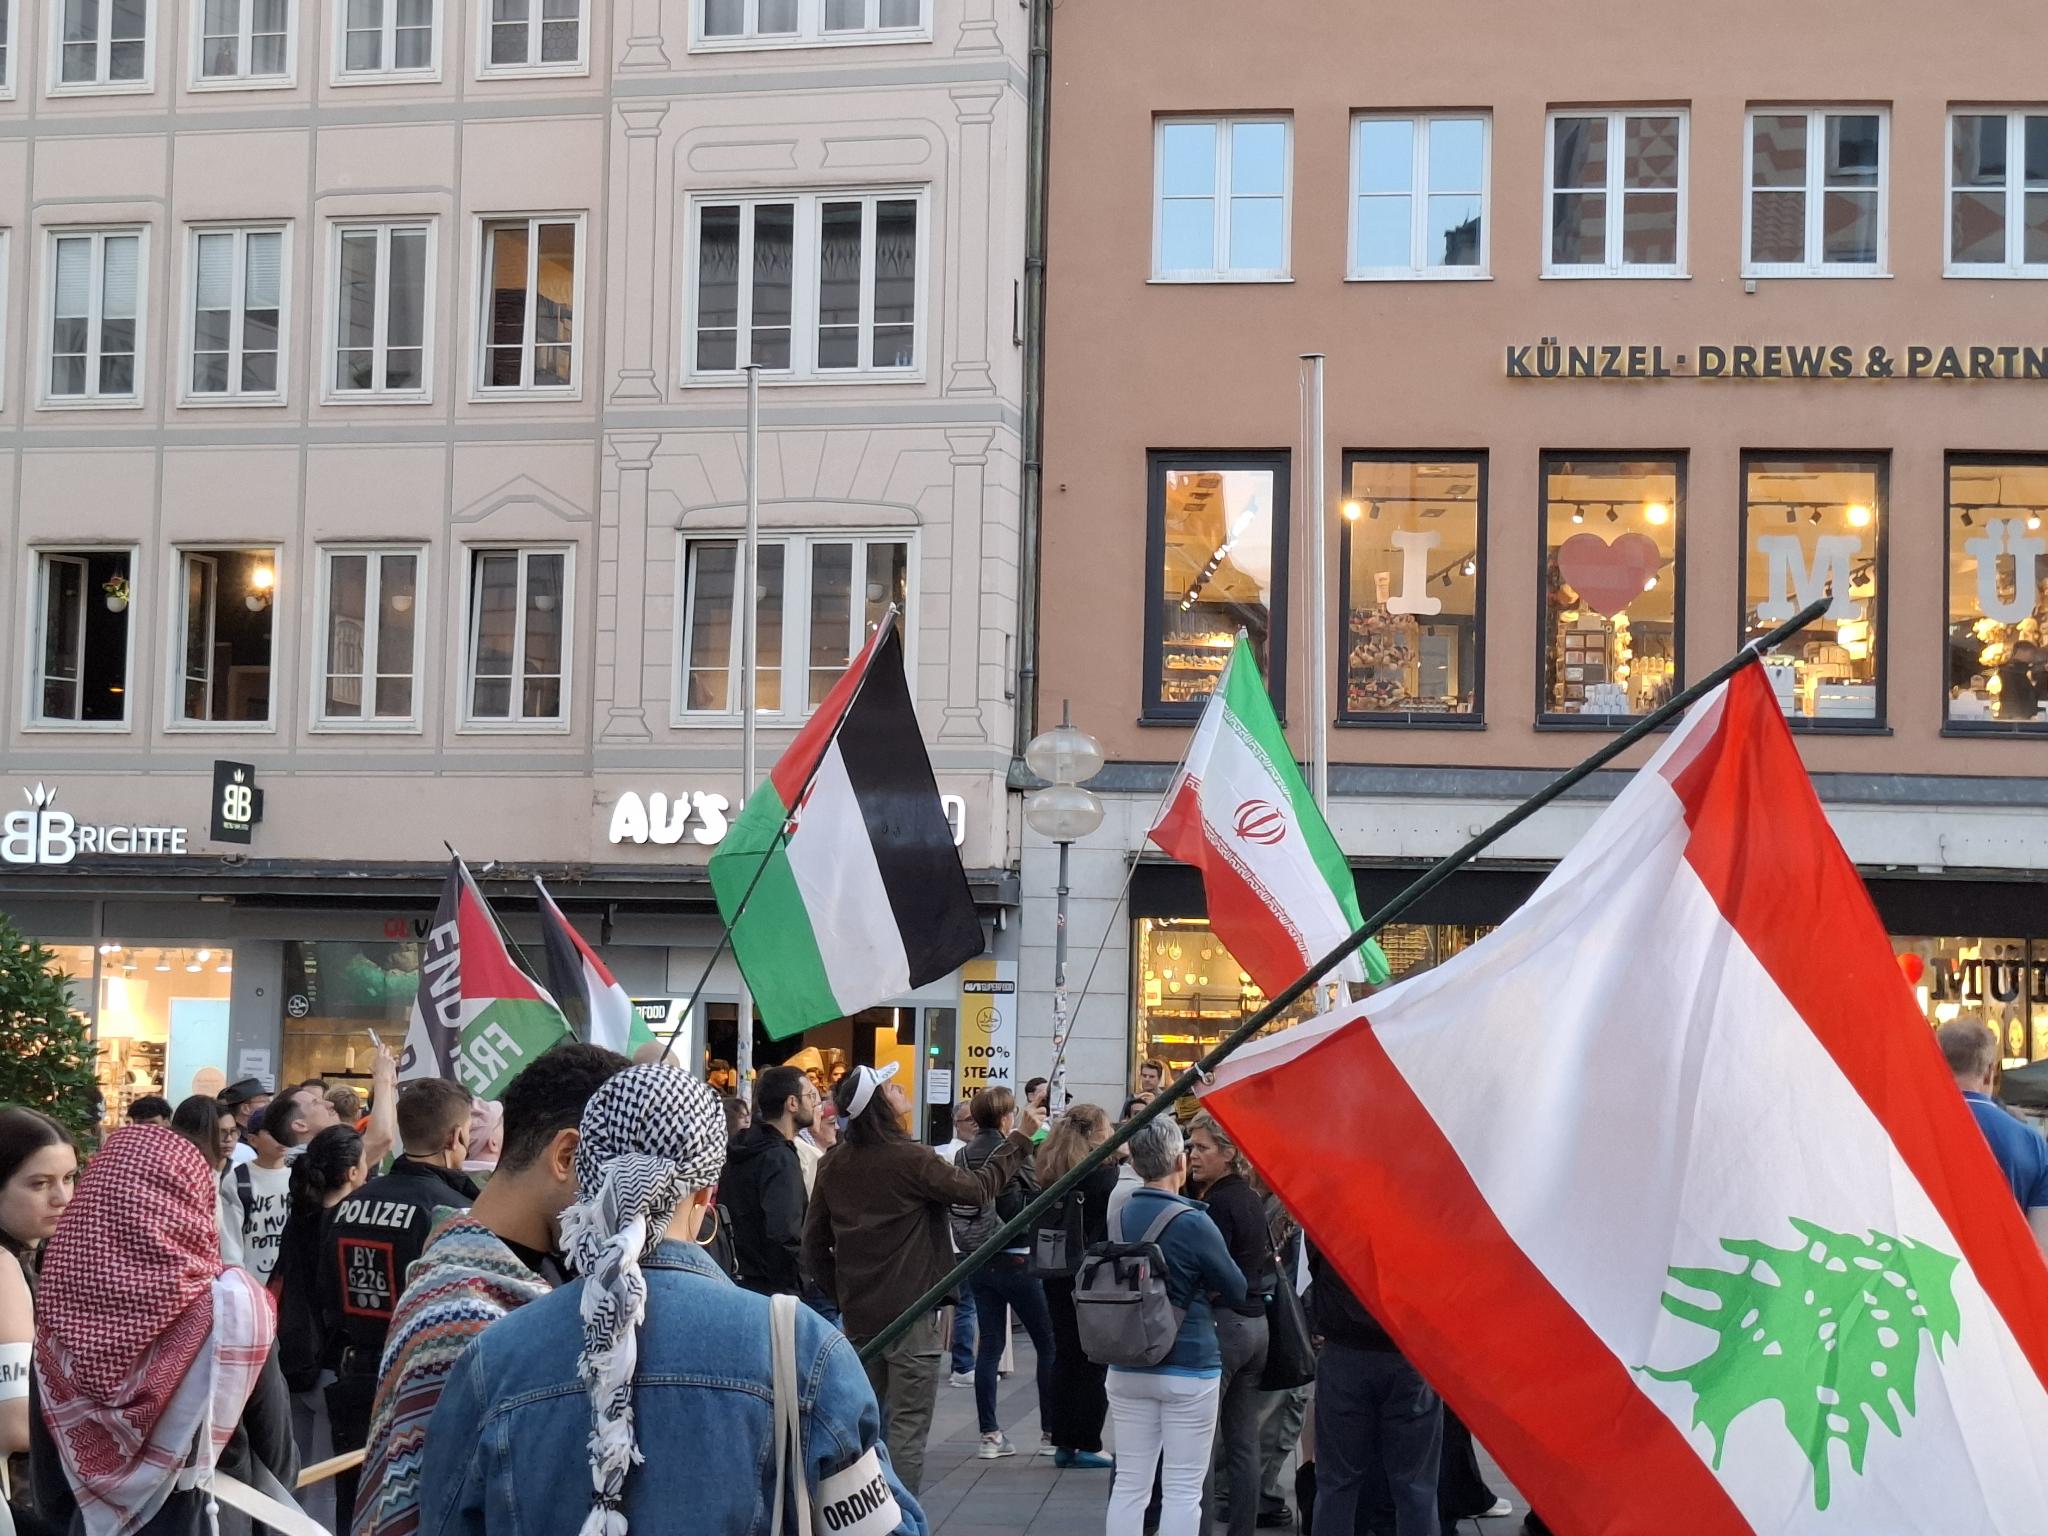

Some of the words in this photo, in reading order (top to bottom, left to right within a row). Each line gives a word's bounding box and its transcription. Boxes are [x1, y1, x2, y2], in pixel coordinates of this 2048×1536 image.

[1506, 337, 1671, 377] KÜNZEL
[1699, 345, 1853, 377] DREWS
[1867, 345, 1894, 377] &
[1908, 346, 2048, 377] PARTN
[967, 1045, 1010, 1058] 100%
[964, 1066, 1009, 1079] STEAK
[334, 1199, 417, 1229] POLIZEI
[353, 1246, 377, 1269] BY
